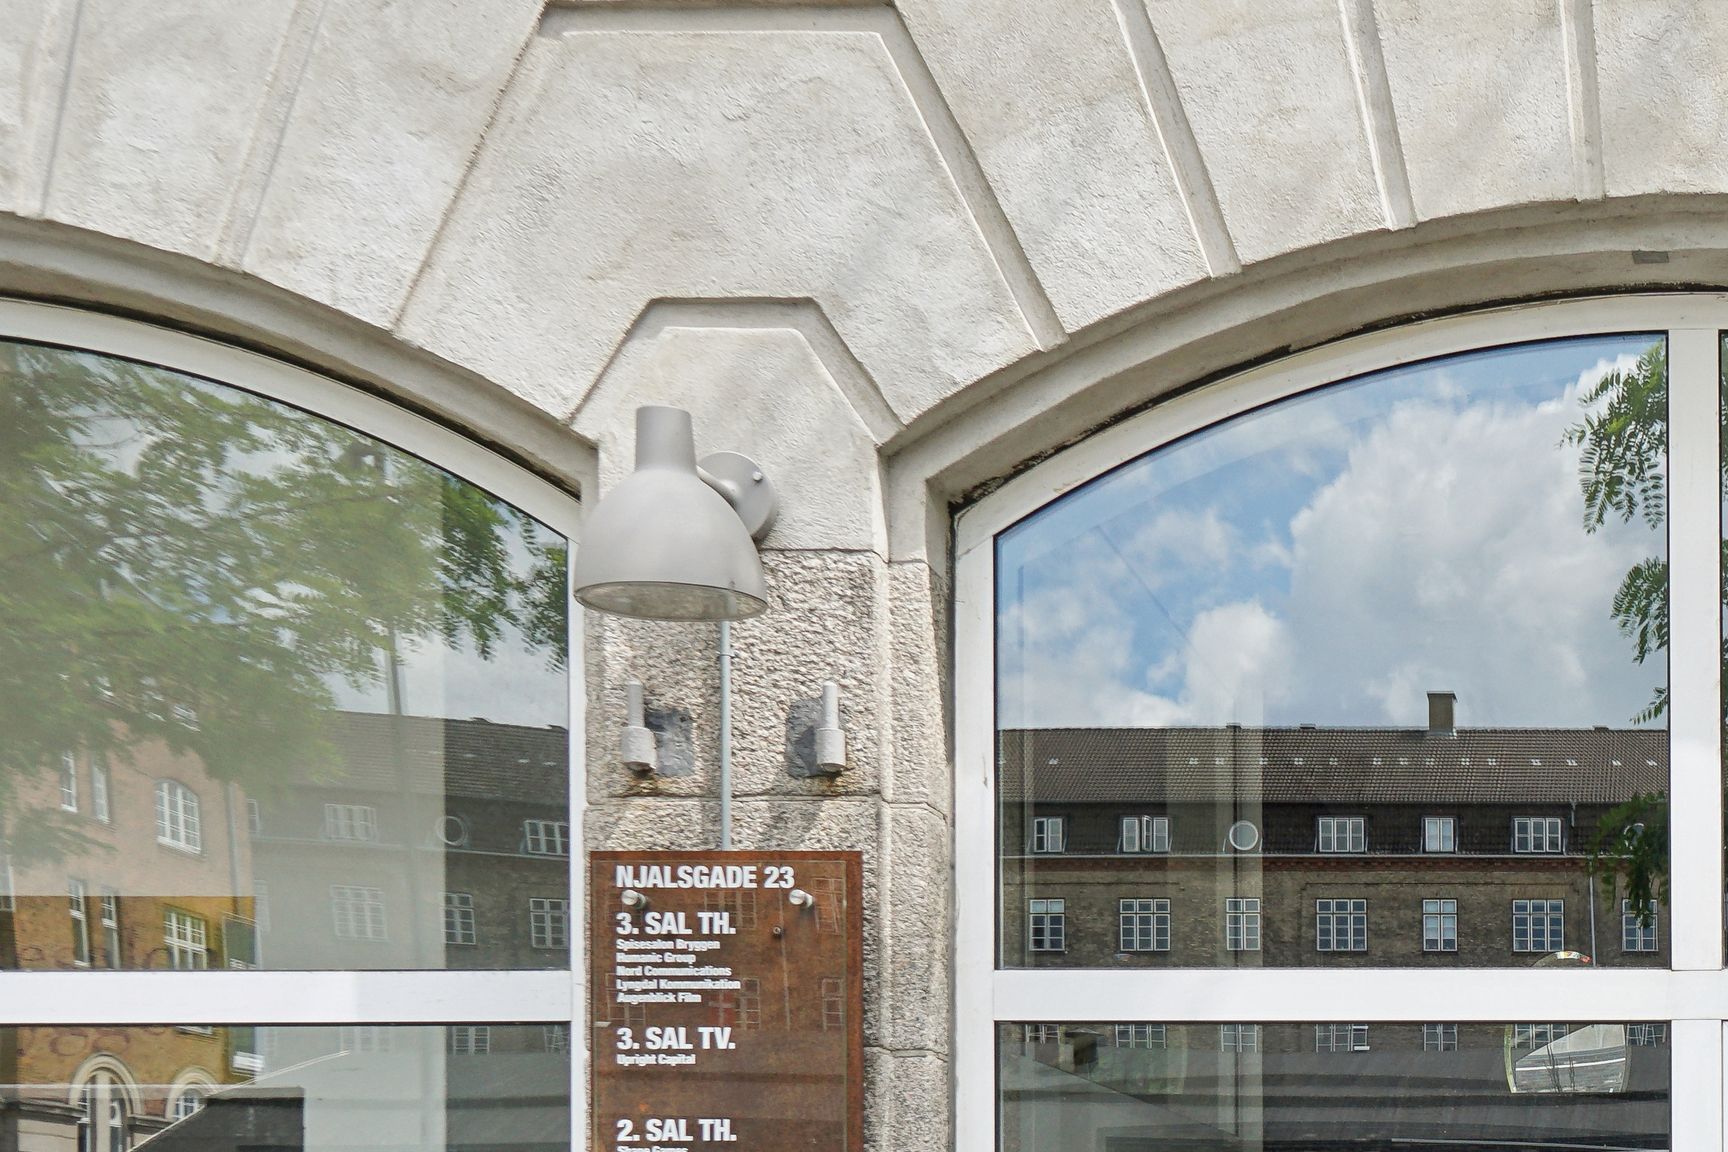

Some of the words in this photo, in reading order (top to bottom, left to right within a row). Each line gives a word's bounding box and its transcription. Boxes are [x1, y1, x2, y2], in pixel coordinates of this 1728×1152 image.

[617, 866, 757, 888] NJALSGADE
[764, 866, 794, 888] 23
[616, 913, 639, 934] 3.
[645, 912, 692, 934] SAL
[698, 912, 736, 934] TH.
[676, 939, 720, 951] Bryggen
[664, 952, 696, 964] Group
[644, 966, 731, 976] Communications
[660, 979, 740, 989] Kommunikation
[617, 993, 676, 1004] Augenblick
[678, 992, 701, 1002] Film
[617, 1028, 640, 1049] 3.
[646, 1027, 693, 1049] SAL
[698, 1027, 735, 1049] TV.
[617, 1054, 656, 1066] Upright
[658, 1054, 695, 1066] Capital
[617, 1119, 640, 1141] 2.
[646, 1119, 693, 1141] SAL
[698, 1119, 737, 1141] TH.
